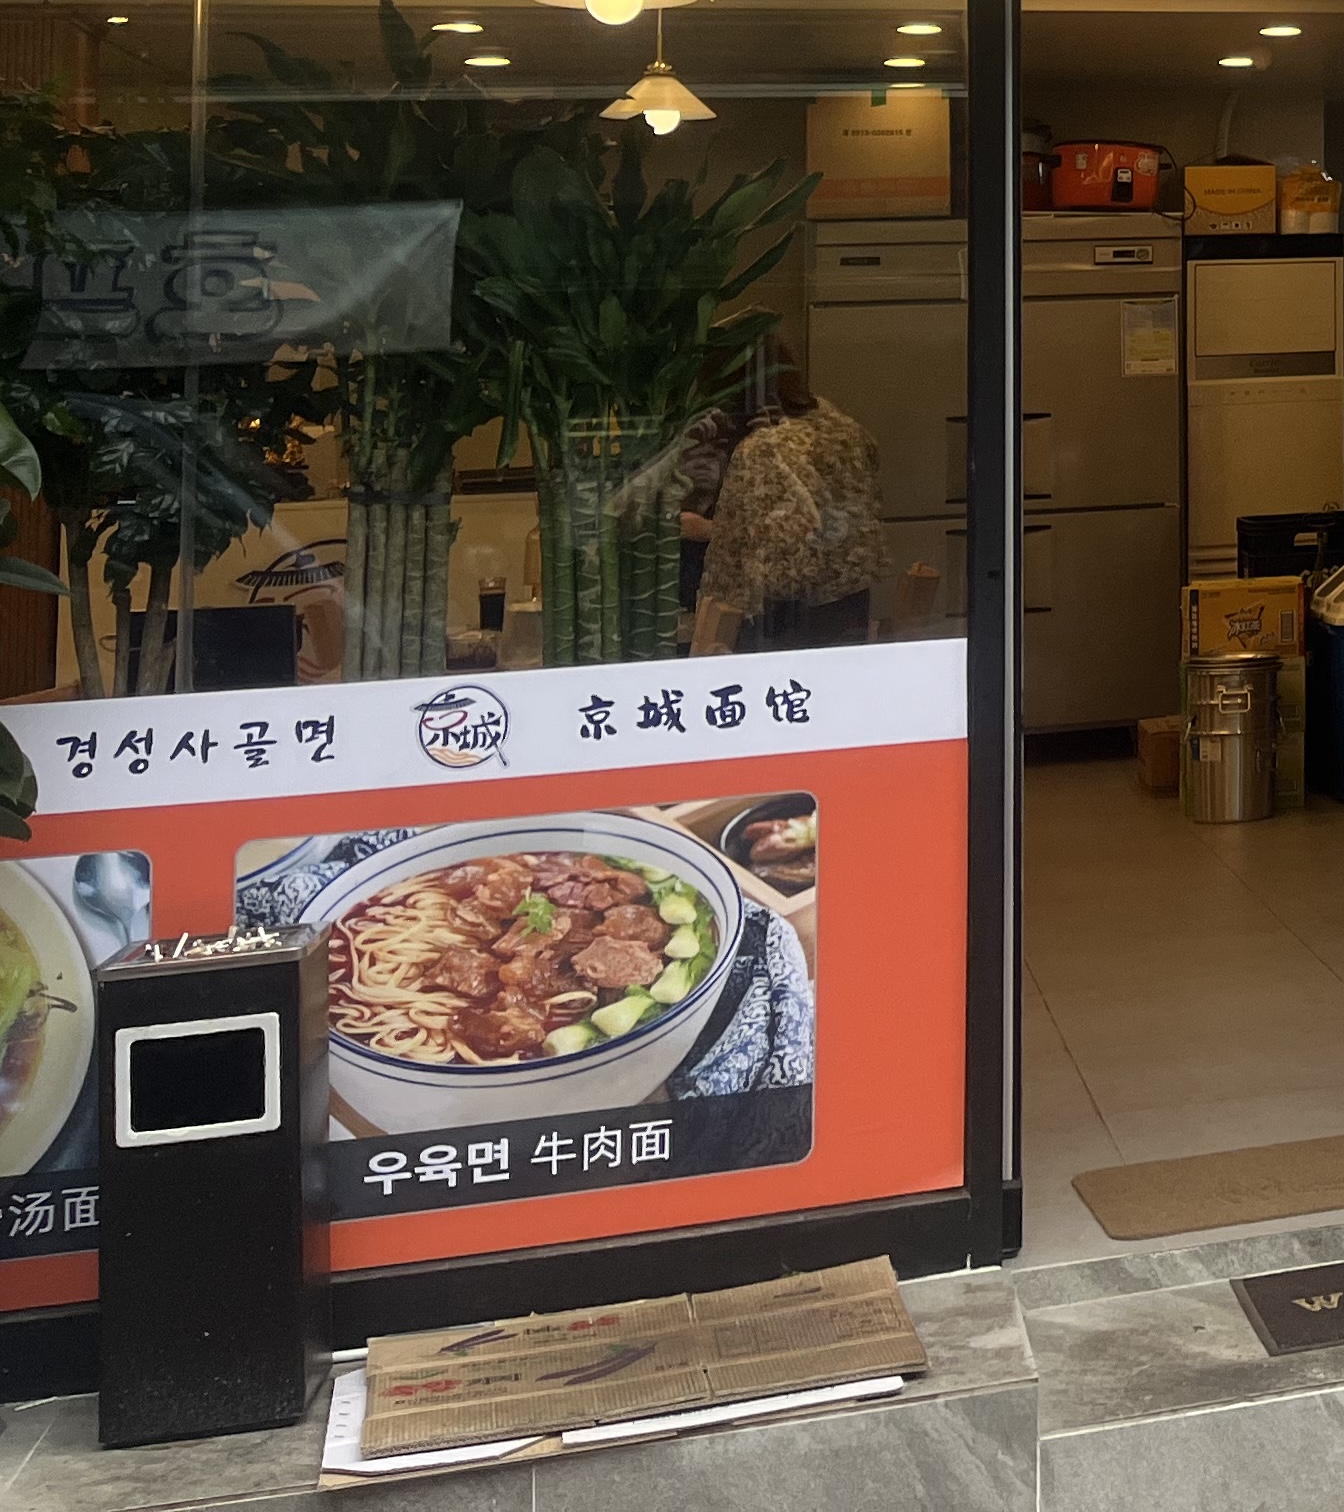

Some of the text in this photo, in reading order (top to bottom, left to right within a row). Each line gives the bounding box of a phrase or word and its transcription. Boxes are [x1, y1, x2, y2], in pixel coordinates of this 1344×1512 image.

[577, 684, 815, 742] 京城面馆
[56, 714, 338, 779] 경성사골면
[363, 1117, 673, 1196] 우육면 牛肉面
[0, 1185, 100, 1237] 汤面
